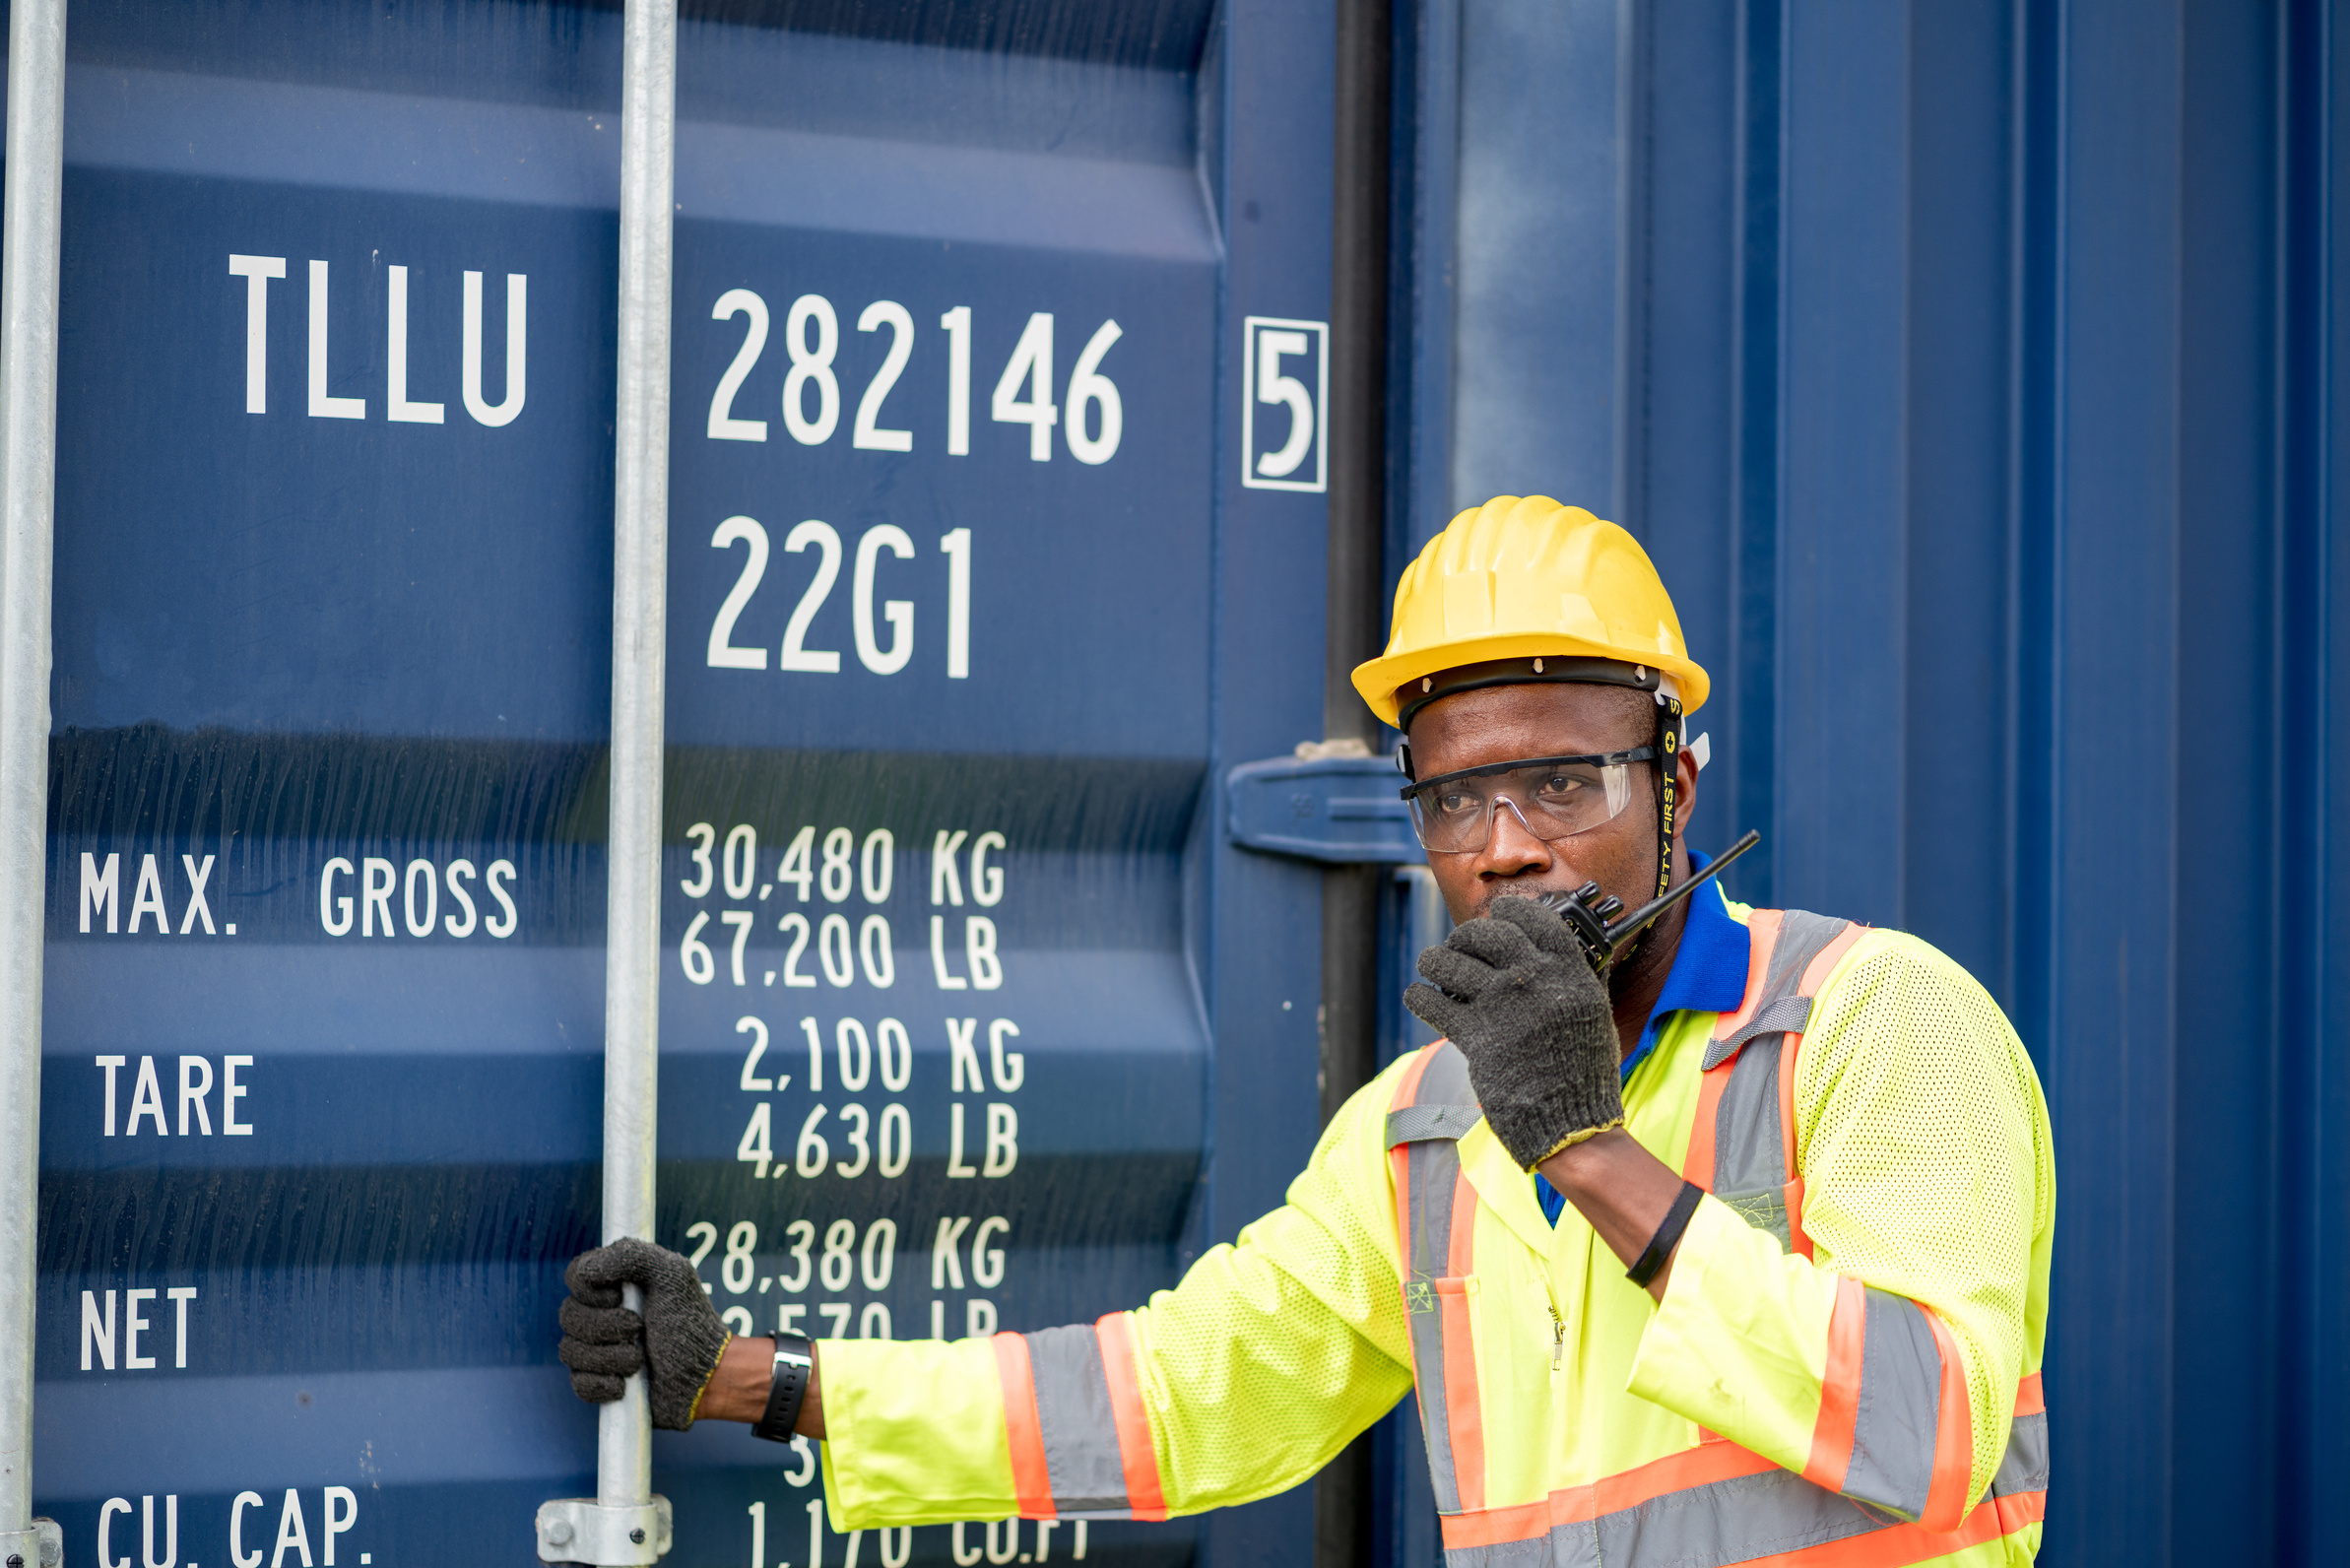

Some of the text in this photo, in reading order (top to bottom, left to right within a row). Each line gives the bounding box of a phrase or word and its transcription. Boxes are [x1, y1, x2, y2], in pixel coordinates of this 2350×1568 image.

[228, 253, 1315, 479] TLLU 282146 5
[707, 515, 971, 679] 22G1
[1664, 771, 1675, 835] FIRST
[79, 852, 519, 939] MAX. GROSS
[681, 822, 1007, 906] 30,480 KG
[680, 910, 1004, 990] 67,200 LB
[736, 1016, 1025, 1092] 2,100 KG
[96, 1055, 254, 1137] TARE
[737, 1102, 1018, 1179] 4,630 LB
[686, 1216, 1011, 1295] 28,380 KG
[81, 1286, 197, 1371] NET
[229, 1485, 372, 1568] CAP.
